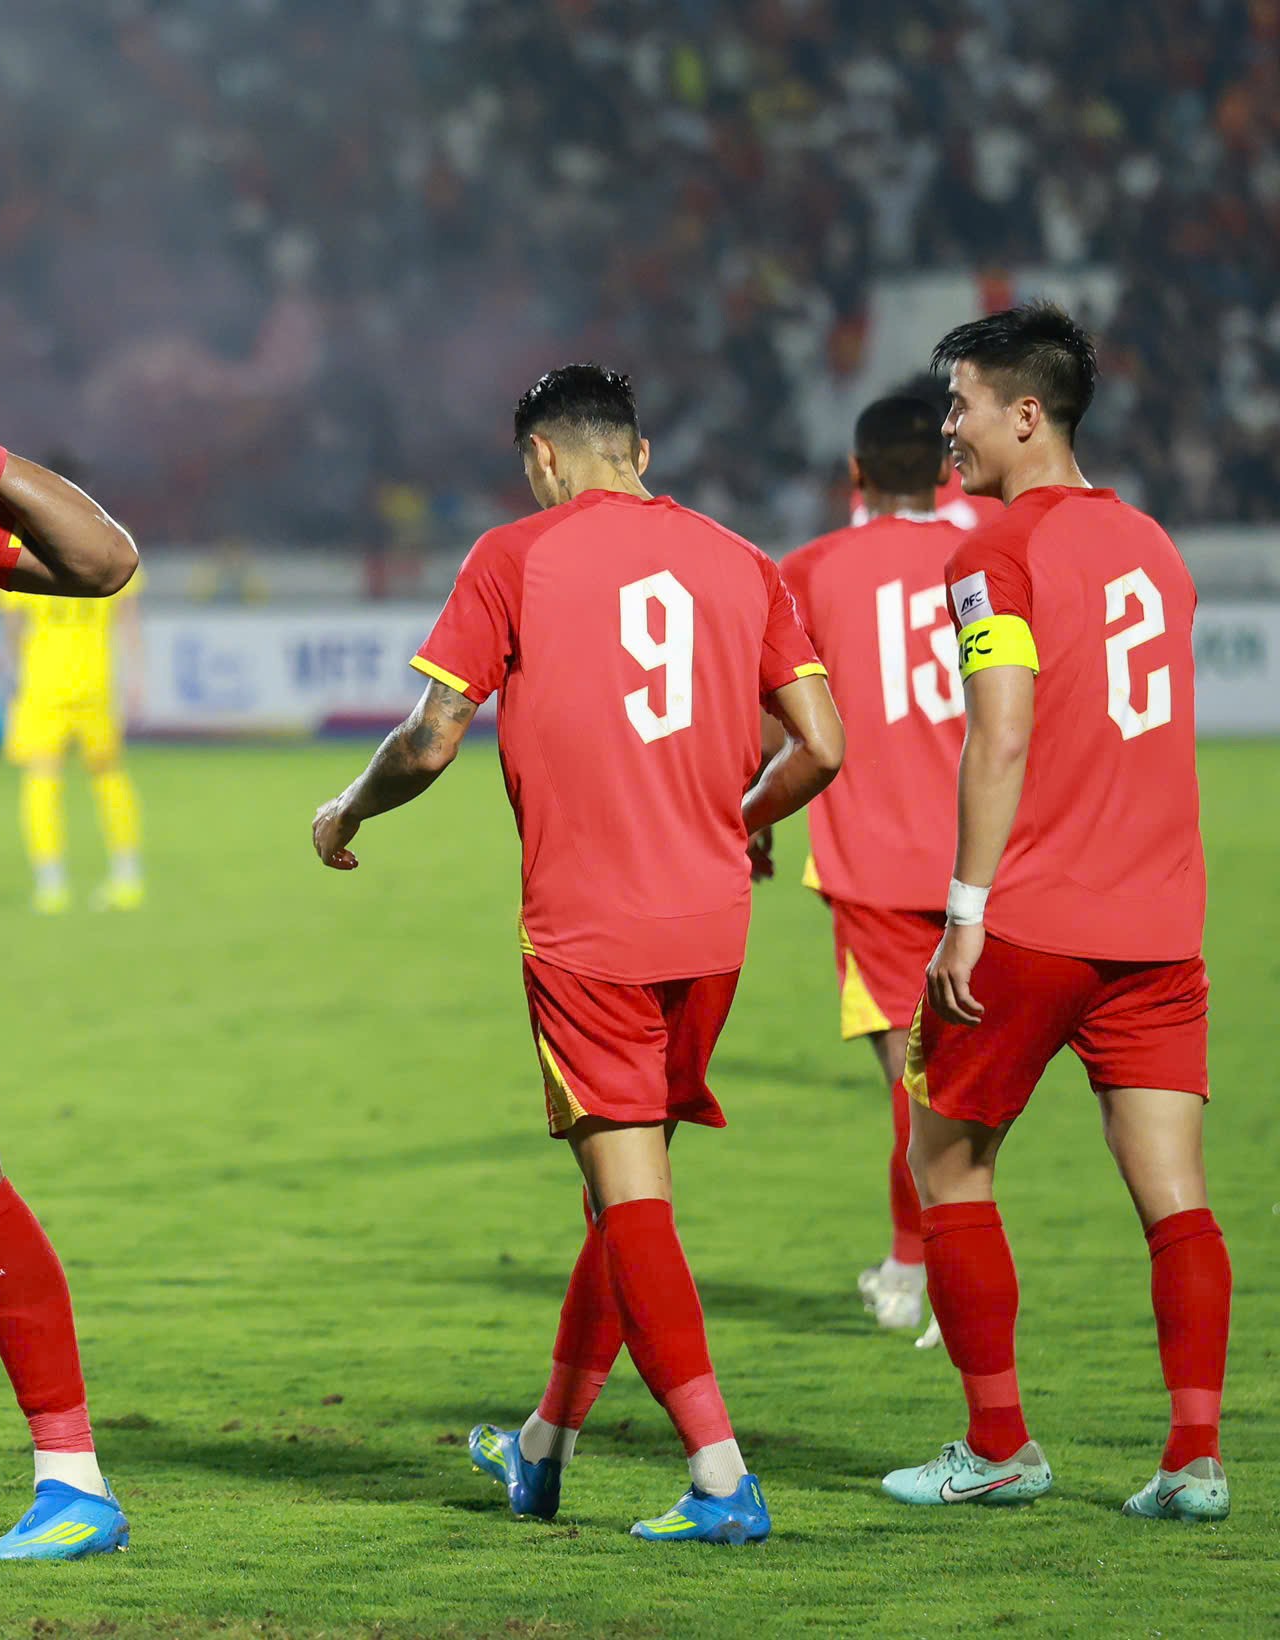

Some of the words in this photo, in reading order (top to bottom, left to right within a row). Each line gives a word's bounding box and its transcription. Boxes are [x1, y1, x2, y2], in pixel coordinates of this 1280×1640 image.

[619, 569, 694, 745] 9
[876, 579, 966, 725] 13
[961, 590, 984, 612] AFC
[1104, 566, 1172, 741] 2
